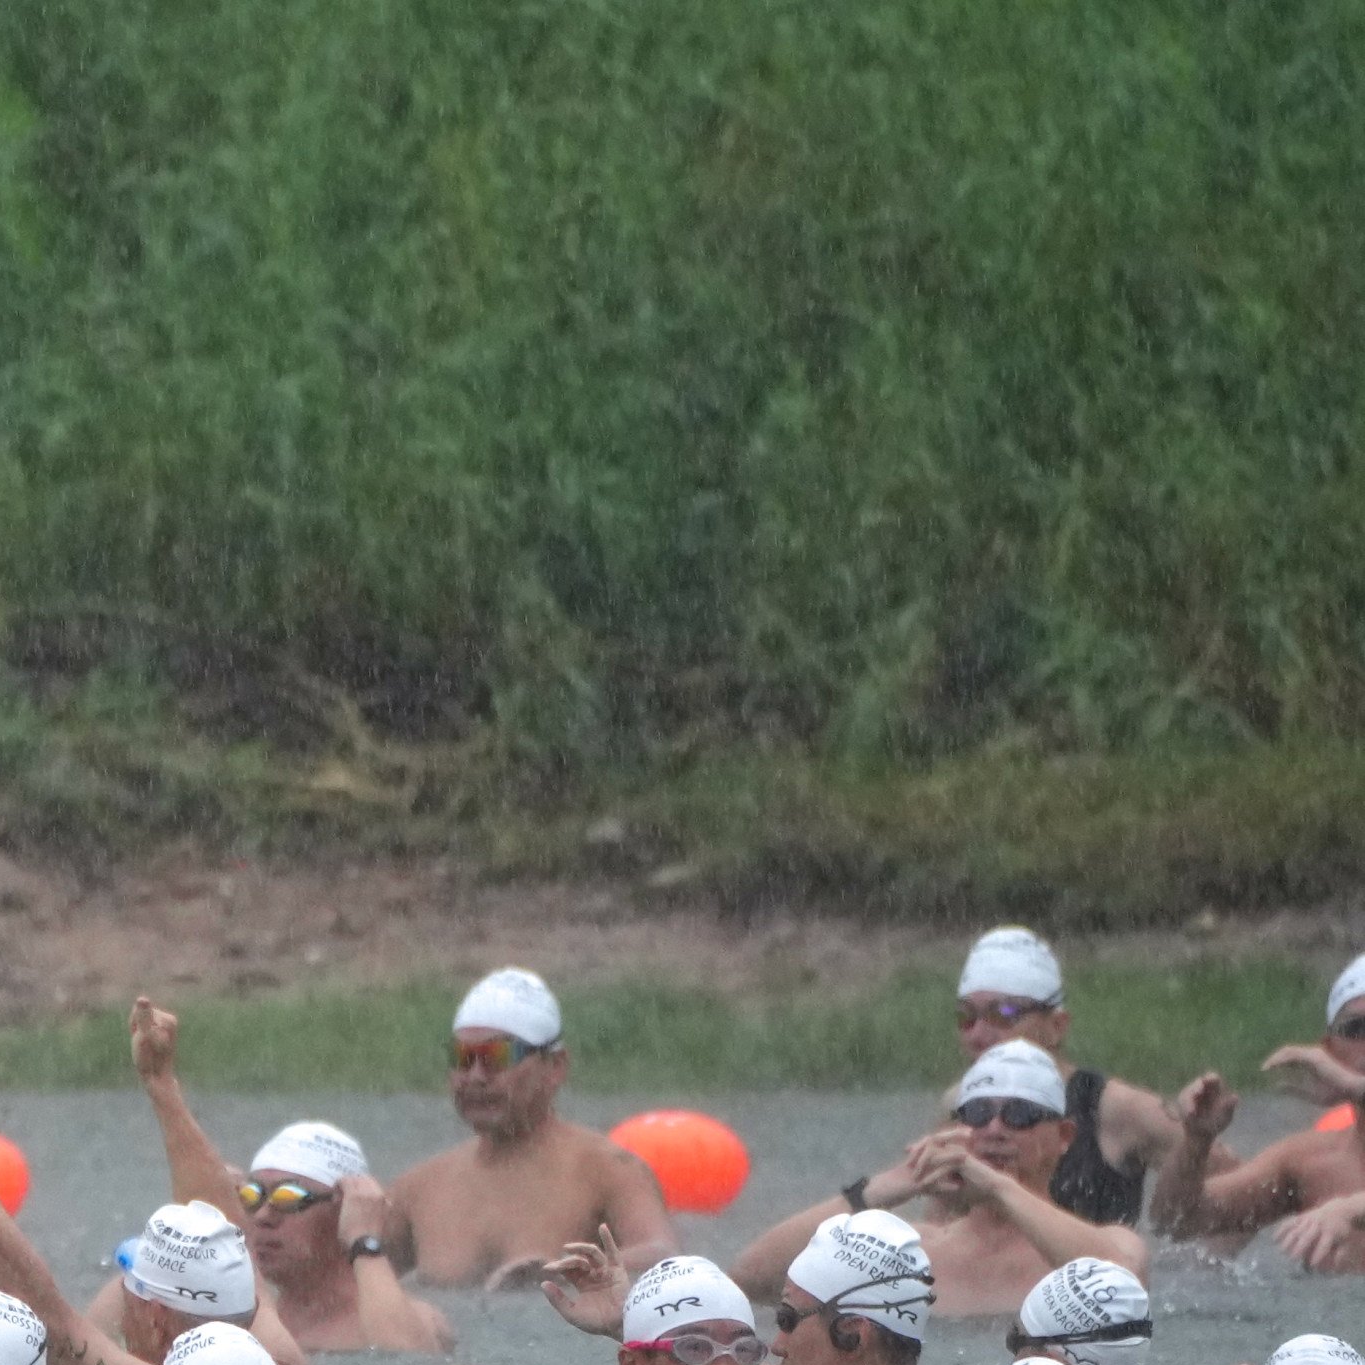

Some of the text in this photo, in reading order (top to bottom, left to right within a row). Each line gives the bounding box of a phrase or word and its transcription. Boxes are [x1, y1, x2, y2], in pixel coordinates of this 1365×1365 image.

[157, 1256, 187, 1273] RACE
[834, 1249, 869, 1273] OPEN
[174, 1286, 219, 1303] TYR
[653, 1296, 703, 1317] TYR
